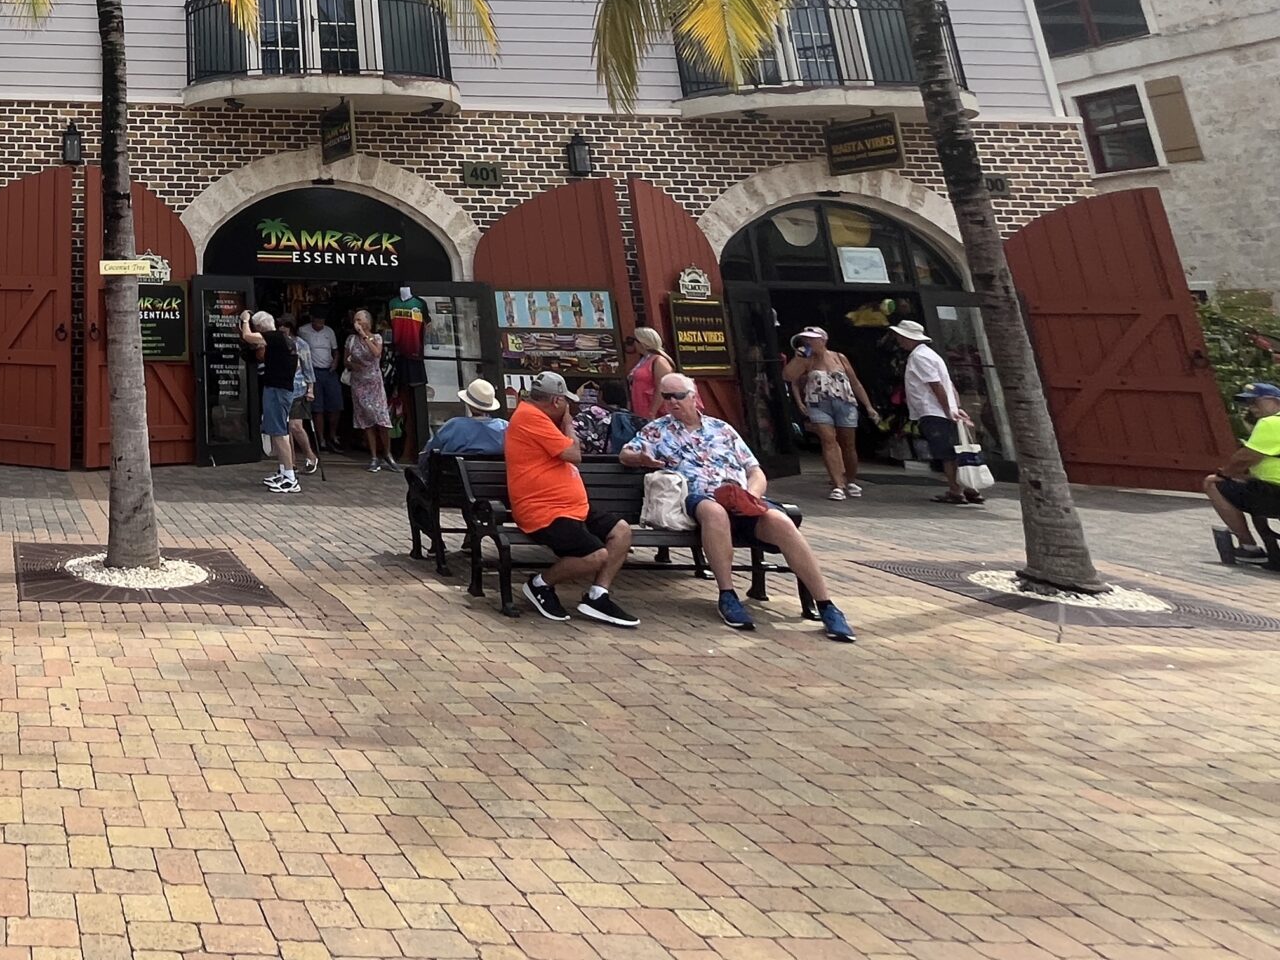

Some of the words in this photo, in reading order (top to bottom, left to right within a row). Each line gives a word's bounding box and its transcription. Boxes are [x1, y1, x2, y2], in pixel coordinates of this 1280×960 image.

[470, 167, 498, 181] 401
[985, 177, 1005, 192] 00
[292, 251, 399, 266] ESSENTIALS
[103, 263, 130, 272] Coconut
[131, 263, 147, 272] Tree
[138, 311, 181, 320] SENTIALS
[677, 330, 703, 343] RASTA
